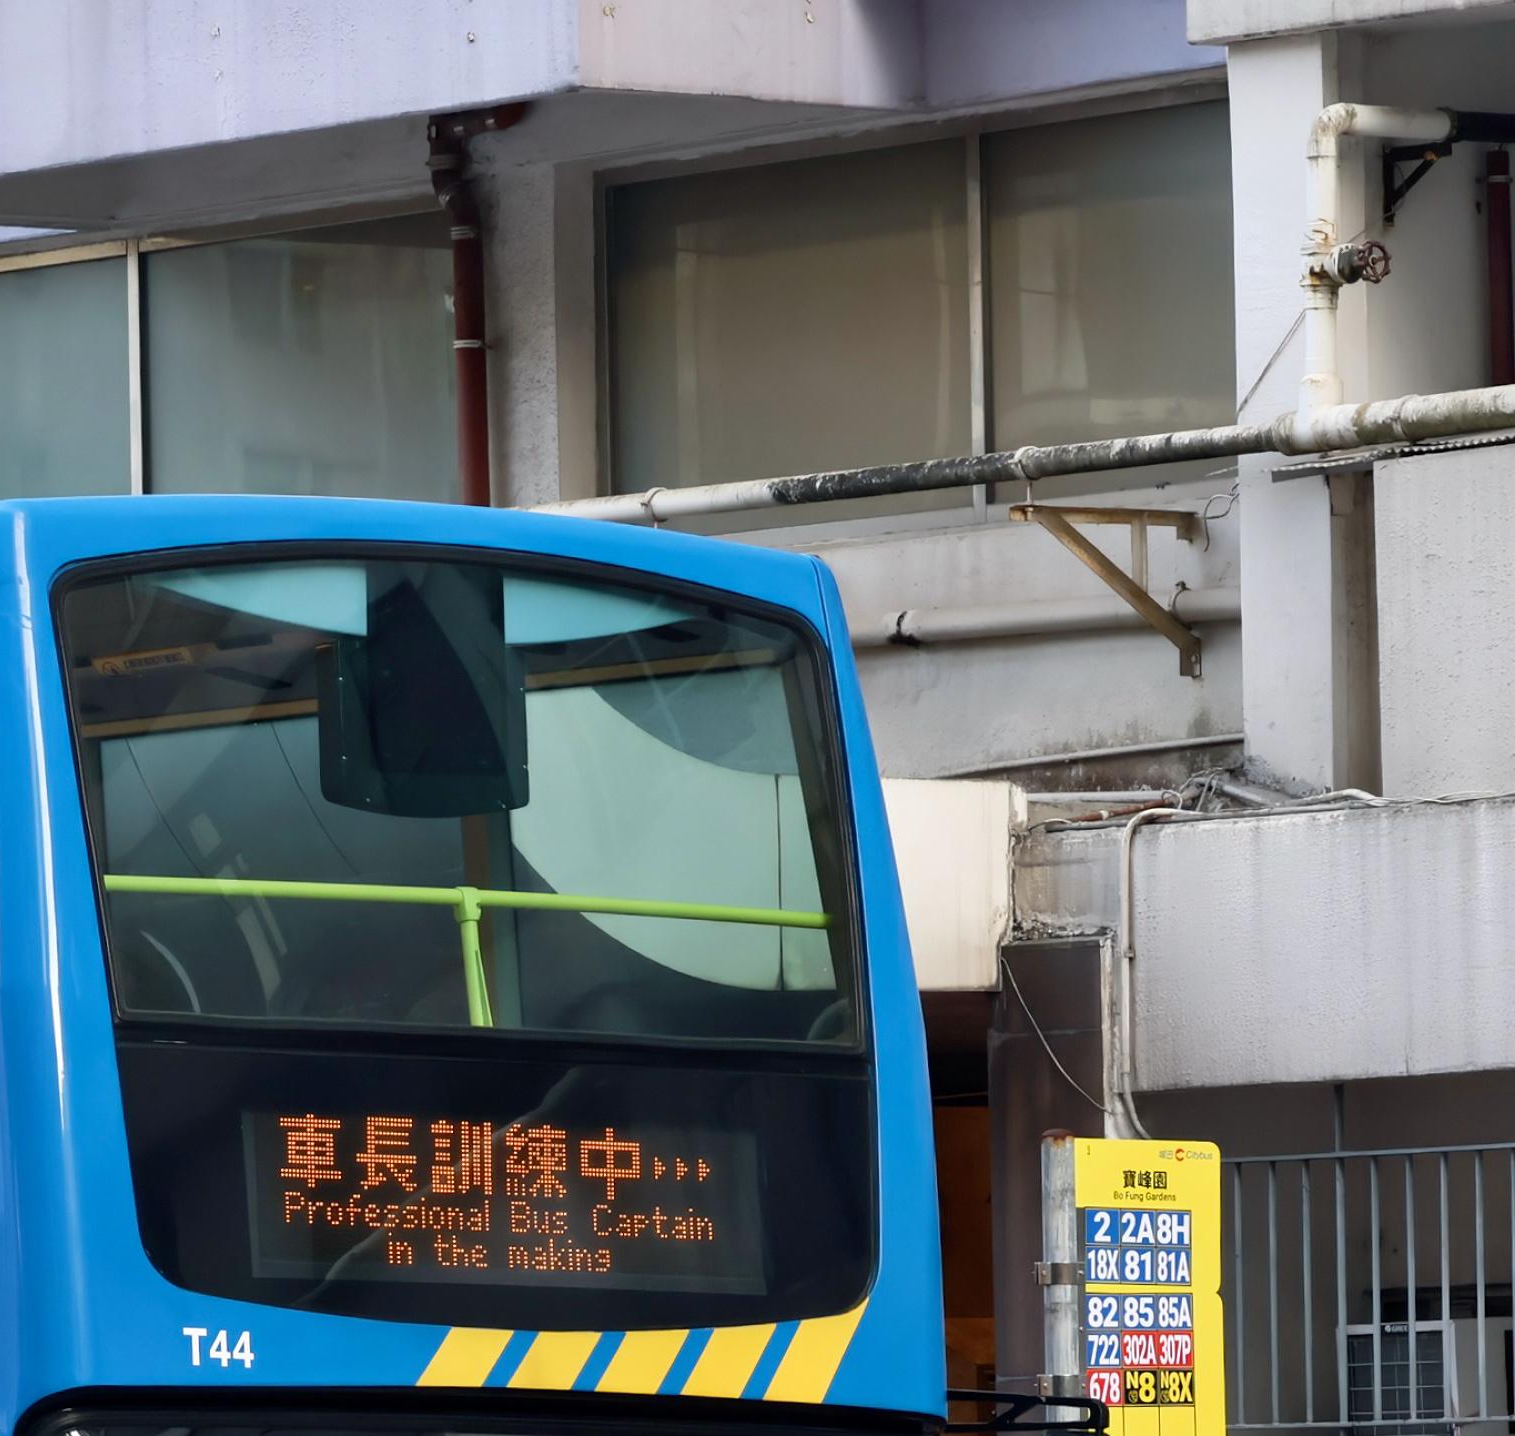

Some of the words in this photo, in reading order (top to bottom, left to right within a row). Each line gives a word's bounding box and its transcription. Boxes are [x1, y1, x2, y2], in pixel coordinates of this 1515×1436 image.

[279, 1113, 641, 1201] 車長訓練中
[1123, 1170, 1168, 1189] 寶峰園
[1113, 1191, 1123, 1200] Bo
[1125, 1191, 1144, 1202] Fung
[1146, 1191, 1176, 1202] Gardens
[283, 1190, 491, 1234] Professional
[510, 1201, 568, 1236] Bus
[592, 1203, 714, 1241] Captain
[1093, 1211, 1111, 1243] 2
[1121, 1212, 1155, 1244] 2A
[1157, 1213, 1190, 1245] 8H
[388, 1231, 414, 1266] in
[433, 1235, 489, 1269] the
[508, 1239, 611, 1272] making
[1088, 1249, 1119, 1281] 18X
[1124, 1250, 1153, 1281] 81
[1157, 1251, 1190, 1282] 81A
[1088, 1297, 1119, 1328] 82
[1124, 1296, 1154, 1328] 85
[1158, 1297, 1192, 1328] 85A
[183, 1327, 255, 1368] T44
[1088, 1334, 1120, 1365] 722
[1123, 1334, 1157, 1365] 302A
[1159, 1334, 1191, 1365] 307P
[1089, 1372, 1120, 1403] 678
